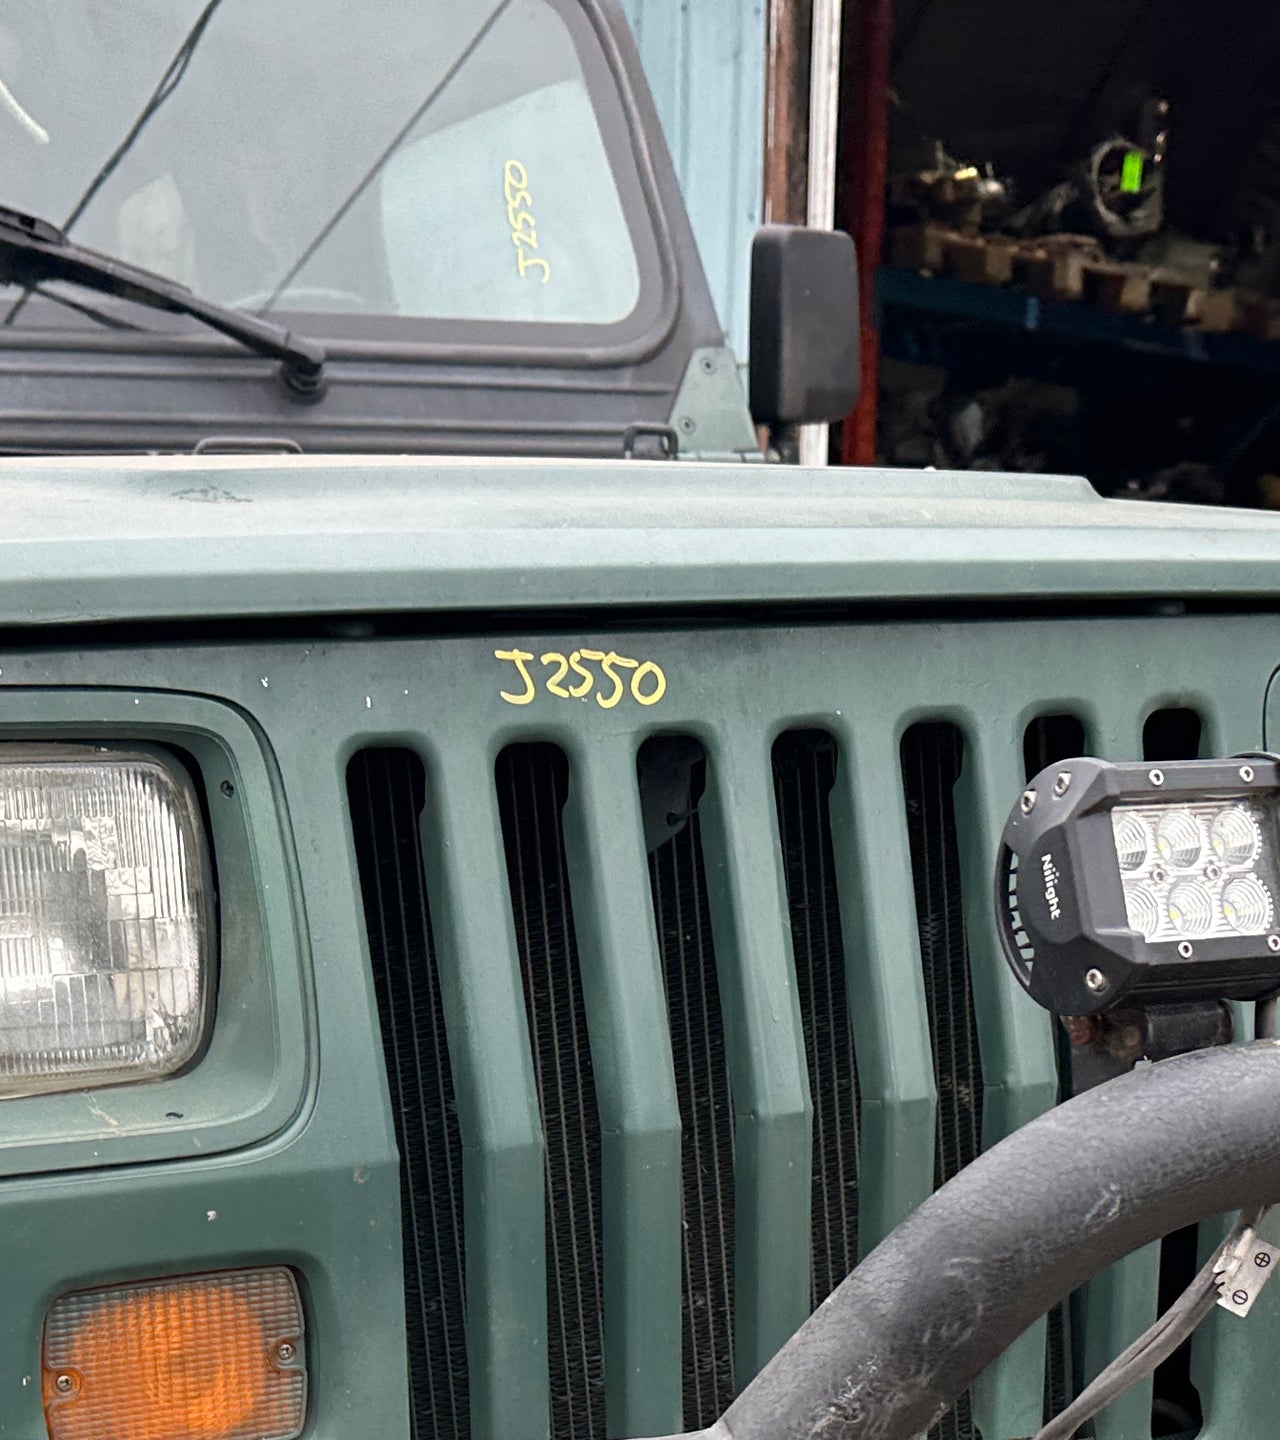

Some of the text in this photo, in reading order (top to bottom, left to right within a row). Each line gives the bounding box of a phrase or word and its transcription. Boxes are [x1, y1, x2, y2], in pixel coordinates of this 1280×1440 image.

[504, 159, 551, 284] J2550
[494, 648, 667, 709] J2550
[1041, 853, 1061, 920] Nilight
